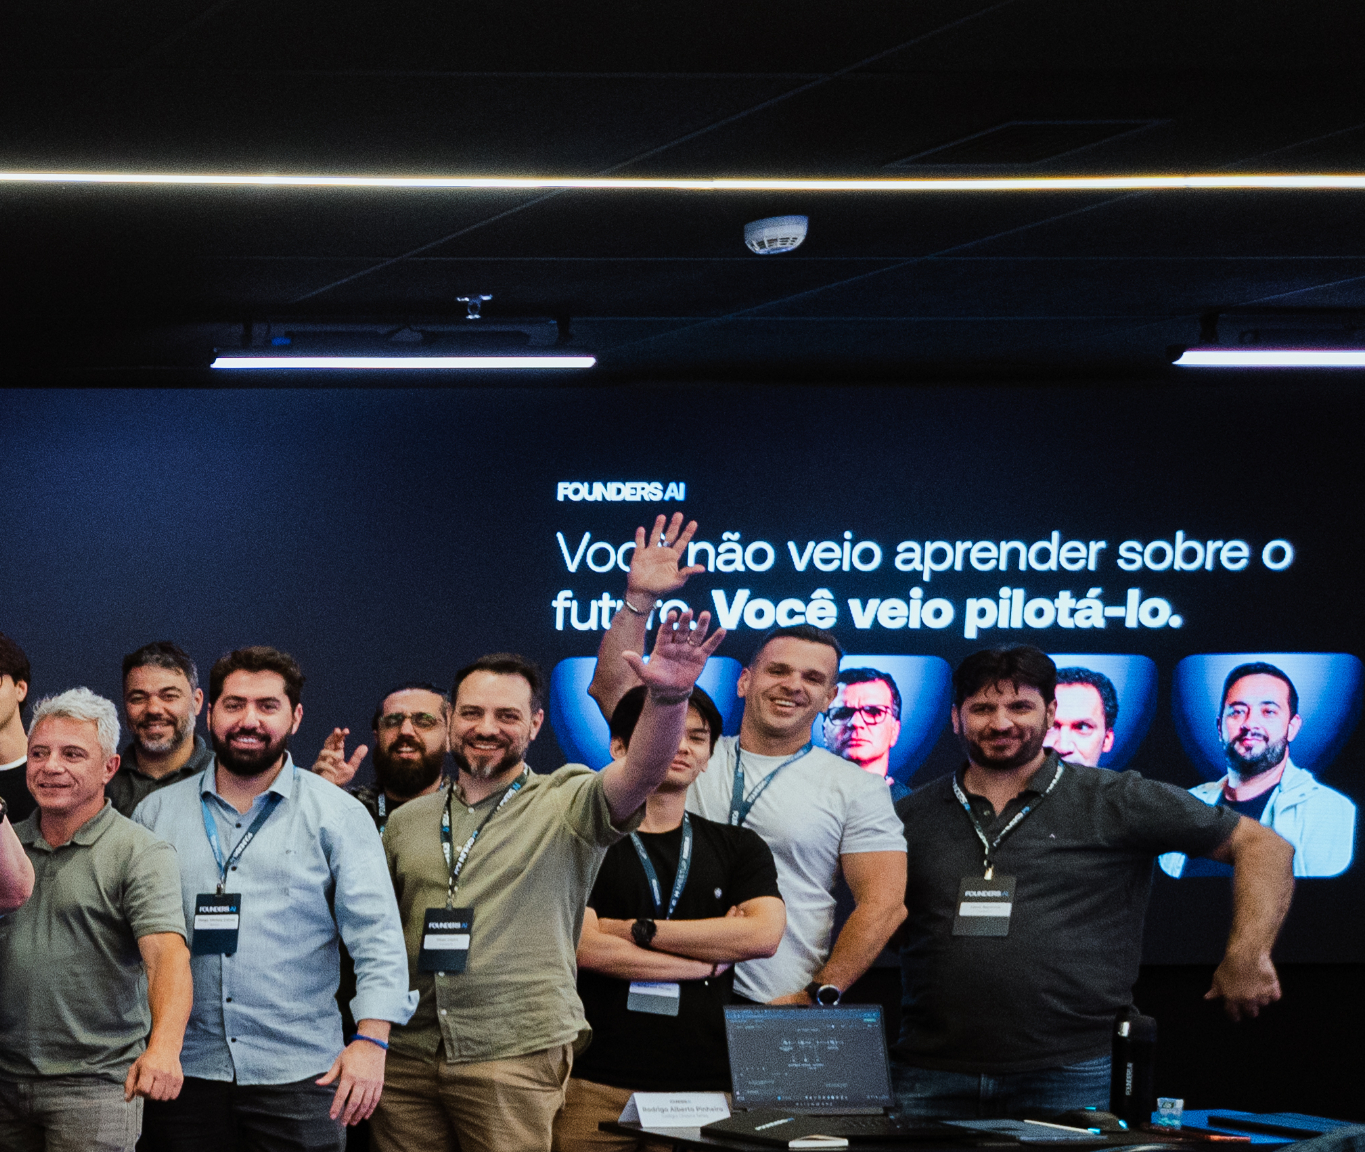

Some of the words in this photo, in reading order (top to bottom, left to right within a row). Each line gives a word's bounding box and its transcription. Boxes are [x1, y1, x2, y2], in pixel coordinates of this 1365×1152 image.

[557, 482, 663, 501] FOUNDERS
[664, 482, 685, 501] AI
[556, 531, 670, 573] Voc
[687, 532, 775, 572] não
[788, 531, 882, 572] veio
[894, 530, 1106, 582] aprender
[1117, 530, 1250, 571] sobre
[1262, 539, 1294, 571] o
[552, 590, 697, 631] futro.
[712, 588, 837, 630] Você
[848, 587, 955, 629] veio
[964, 586, 1183, 639] pilotá-lo.
